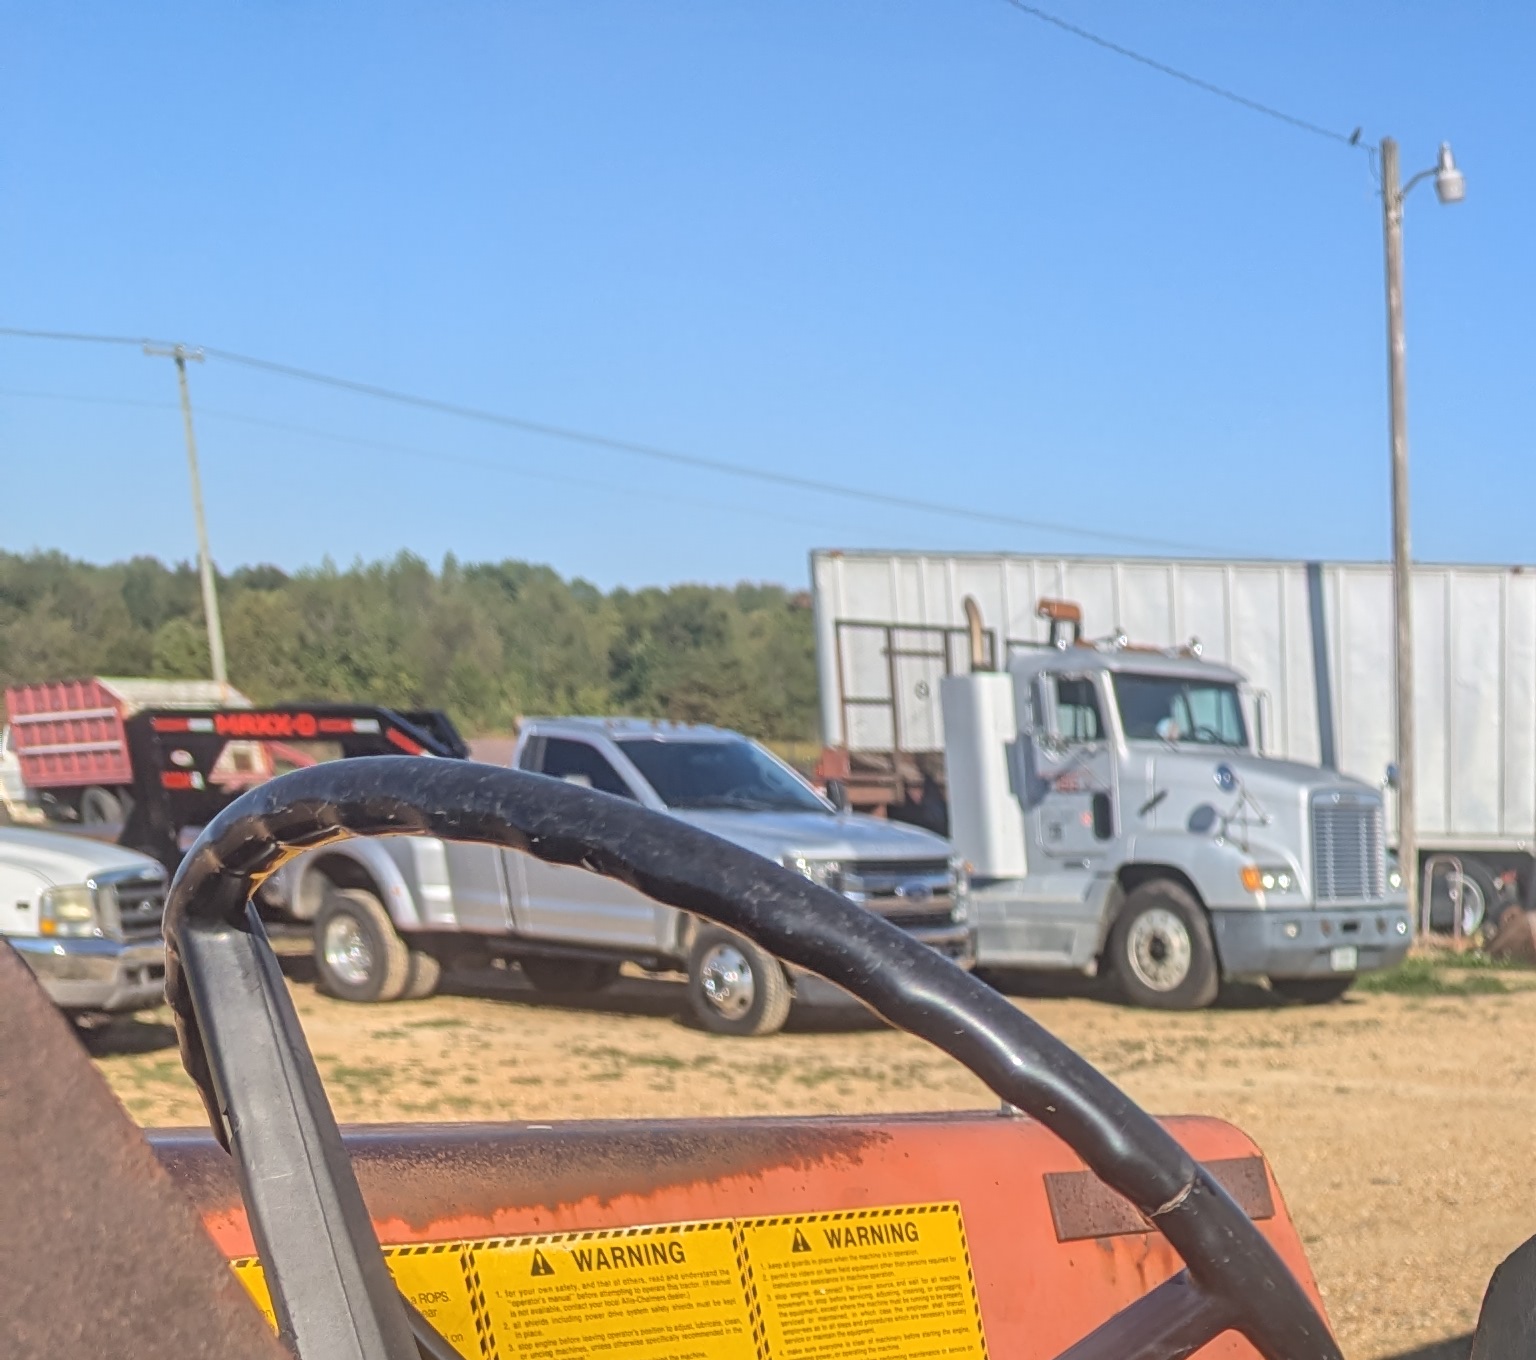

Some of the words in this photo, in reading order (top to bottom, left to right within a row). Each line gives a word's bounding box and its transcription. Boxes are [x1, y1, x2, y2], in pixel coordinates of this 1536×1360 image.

[822, 1221, 919, 1249] WARNING
[570, 1241, 686, 1272] WARNING
[418, 1291, 451, 1304] ROPS.
[451, 1333, 464, 1342] on
